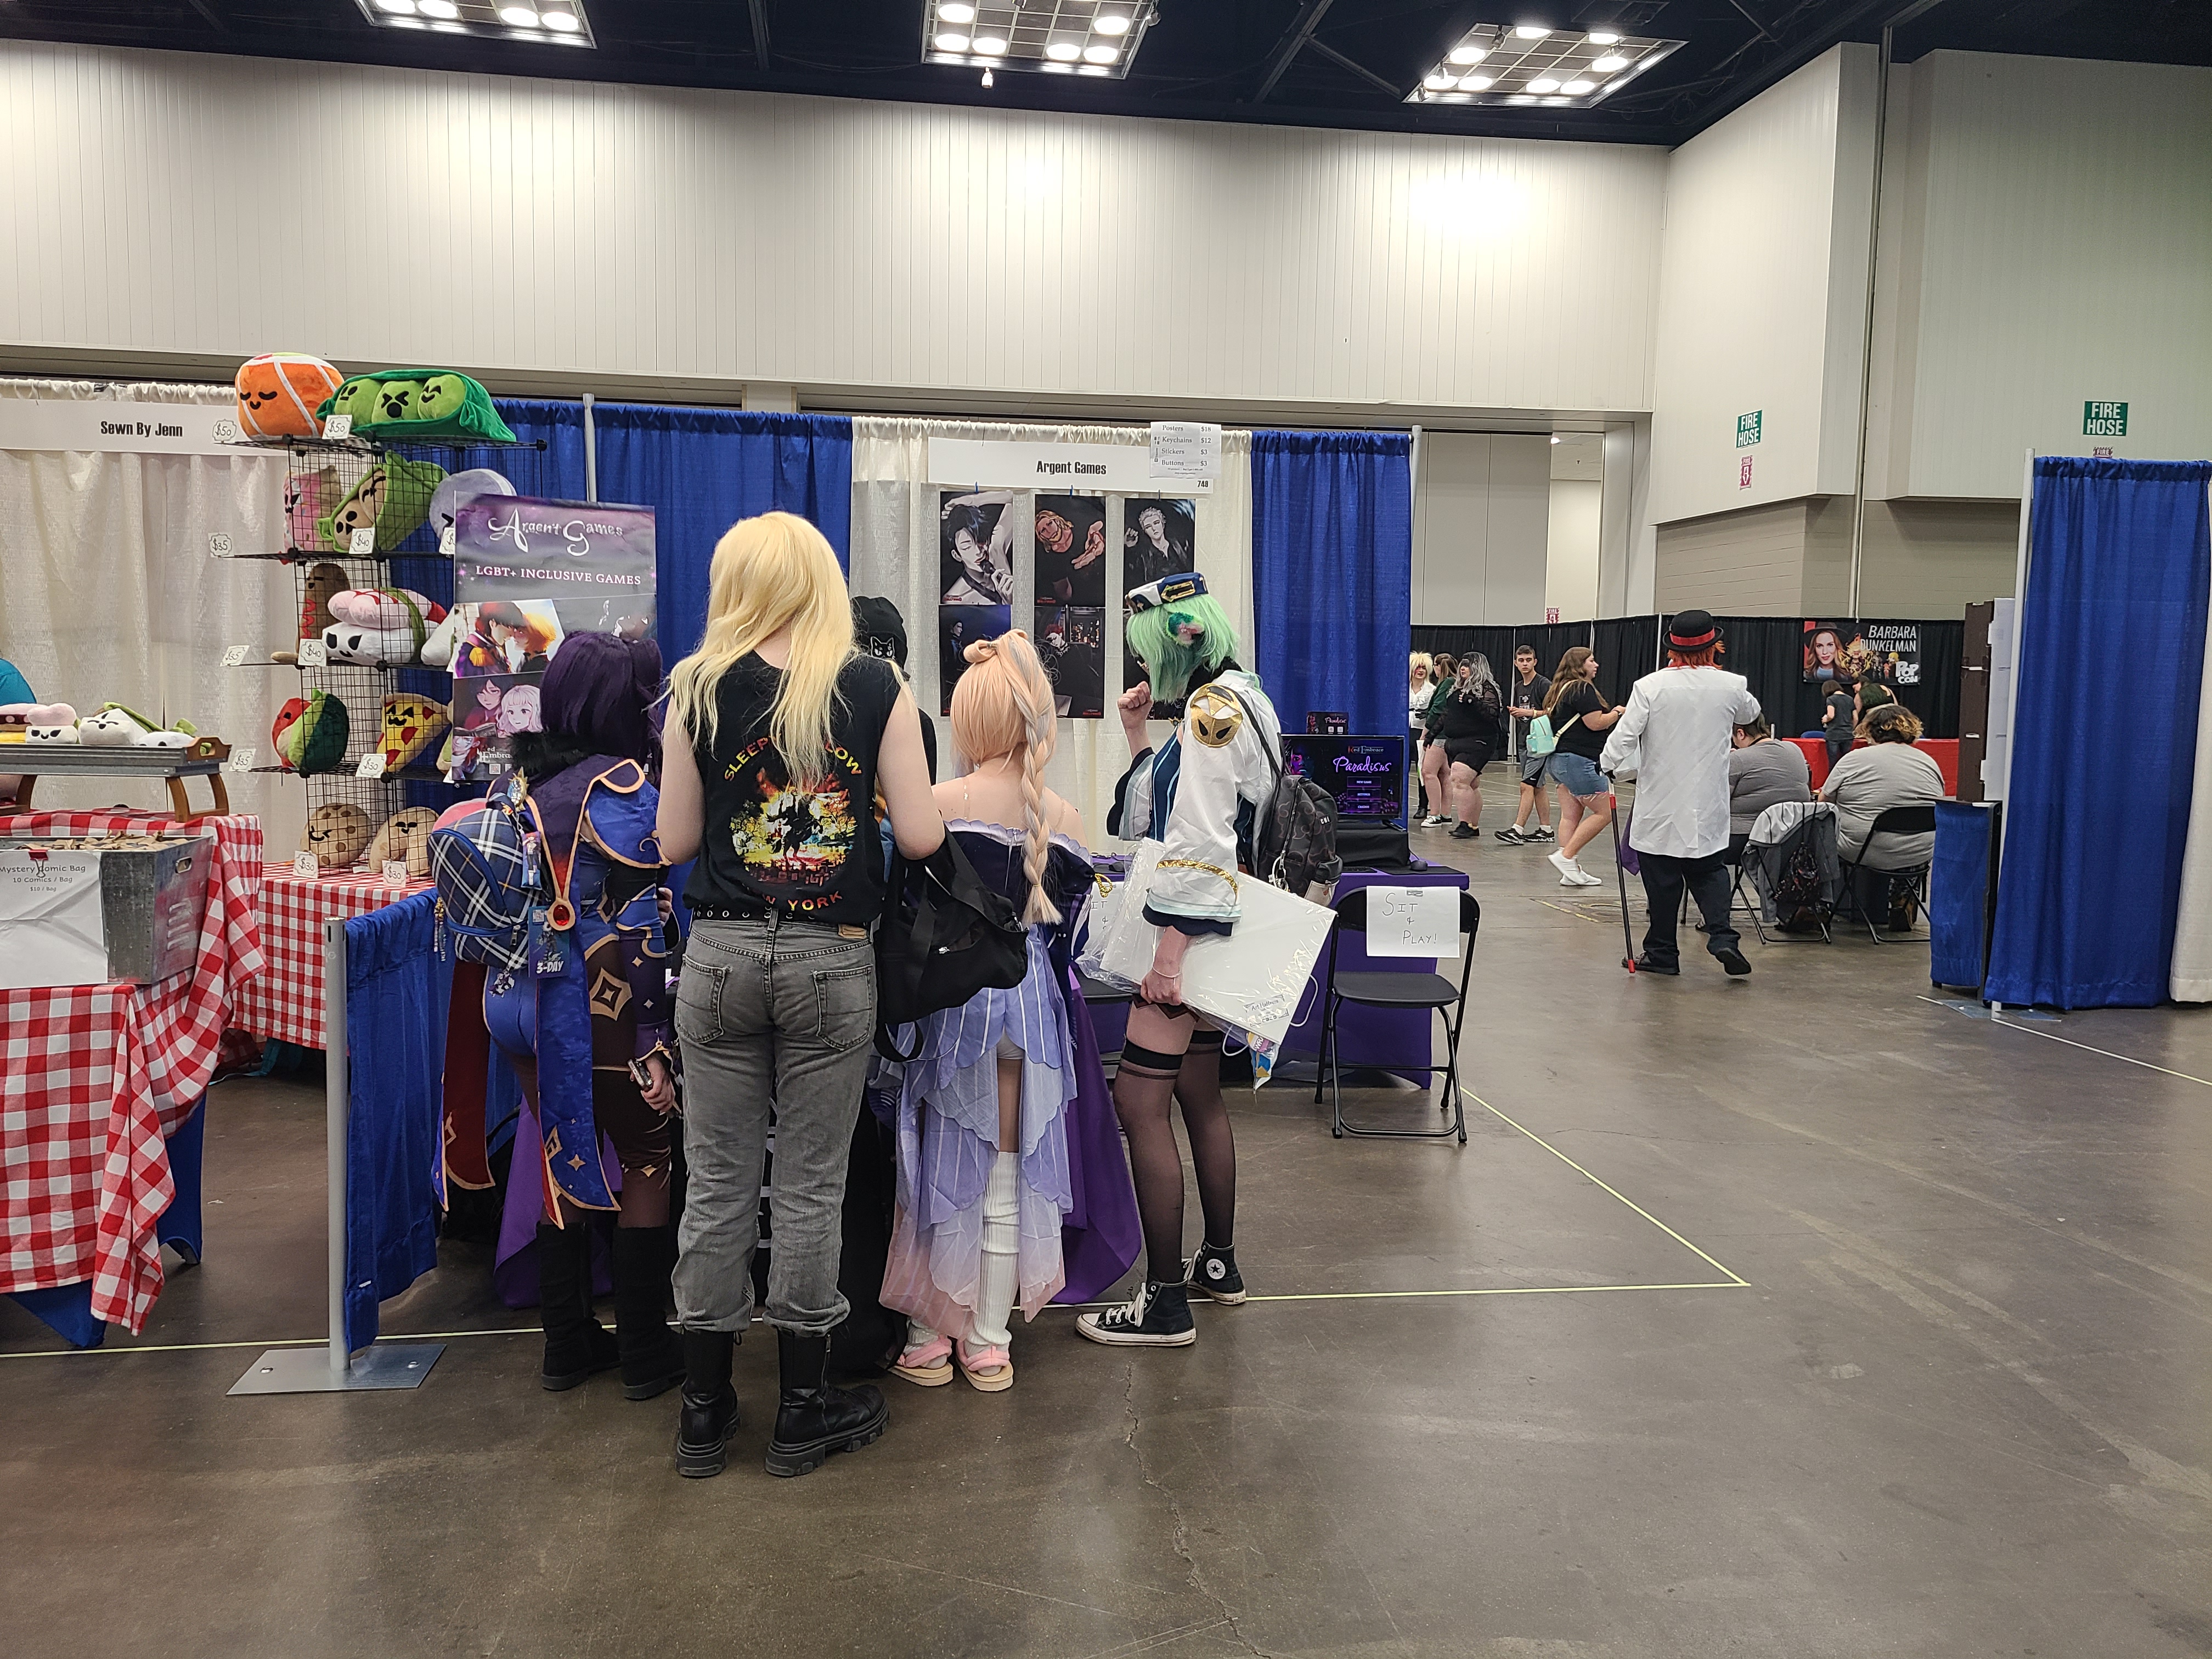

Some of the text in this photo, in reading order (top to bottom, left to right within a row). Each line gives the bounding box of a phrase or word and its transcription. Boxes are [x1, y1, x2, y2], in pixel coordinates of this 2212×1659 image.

[2091, 402, 2121, 419] FIRE
[328, 420, 346, 433] $50
[1741, 412, 1758, 431] FIRE
[2086, 419, 2124, 435] HOSE
[100, 421, 183, 437] Sewn By Jenn
[215, 422, 232, 436] $50
[1737, 427, 1759, 447] HOSE
[1036, 460, 1107, 475] Argent Games
[488, 507, 623, 556] Argent Games
[212, 538, 228, 551] $35
[356, 533, 369, 546] $40
[476, 565, 641, 585] LGBT+ INCLUSIVE GAMES
[1868, 625, 1917, 639] BARBARA
[306, 643, 321, 658] $40
[1860, 639, 1916, 652] DUNKELMAN
[1361, 746, 1384, 754] Embrace
[235, 754, 250, 766] $35
[363, 758, 379, 770] $30
[480, 751, 511, 764] Embra
[1333, 755, 1392, 773] Paradisus
[299, 857, 314, 871] $30
[387, 865, 402, 879] $30
[787, 891, 843, 911] YORK
[1382, 892, 1418, 916] SIT
[1403, 929, 1437, 945] PLAY!
[536, 961, 565, 974] 3-DAY
